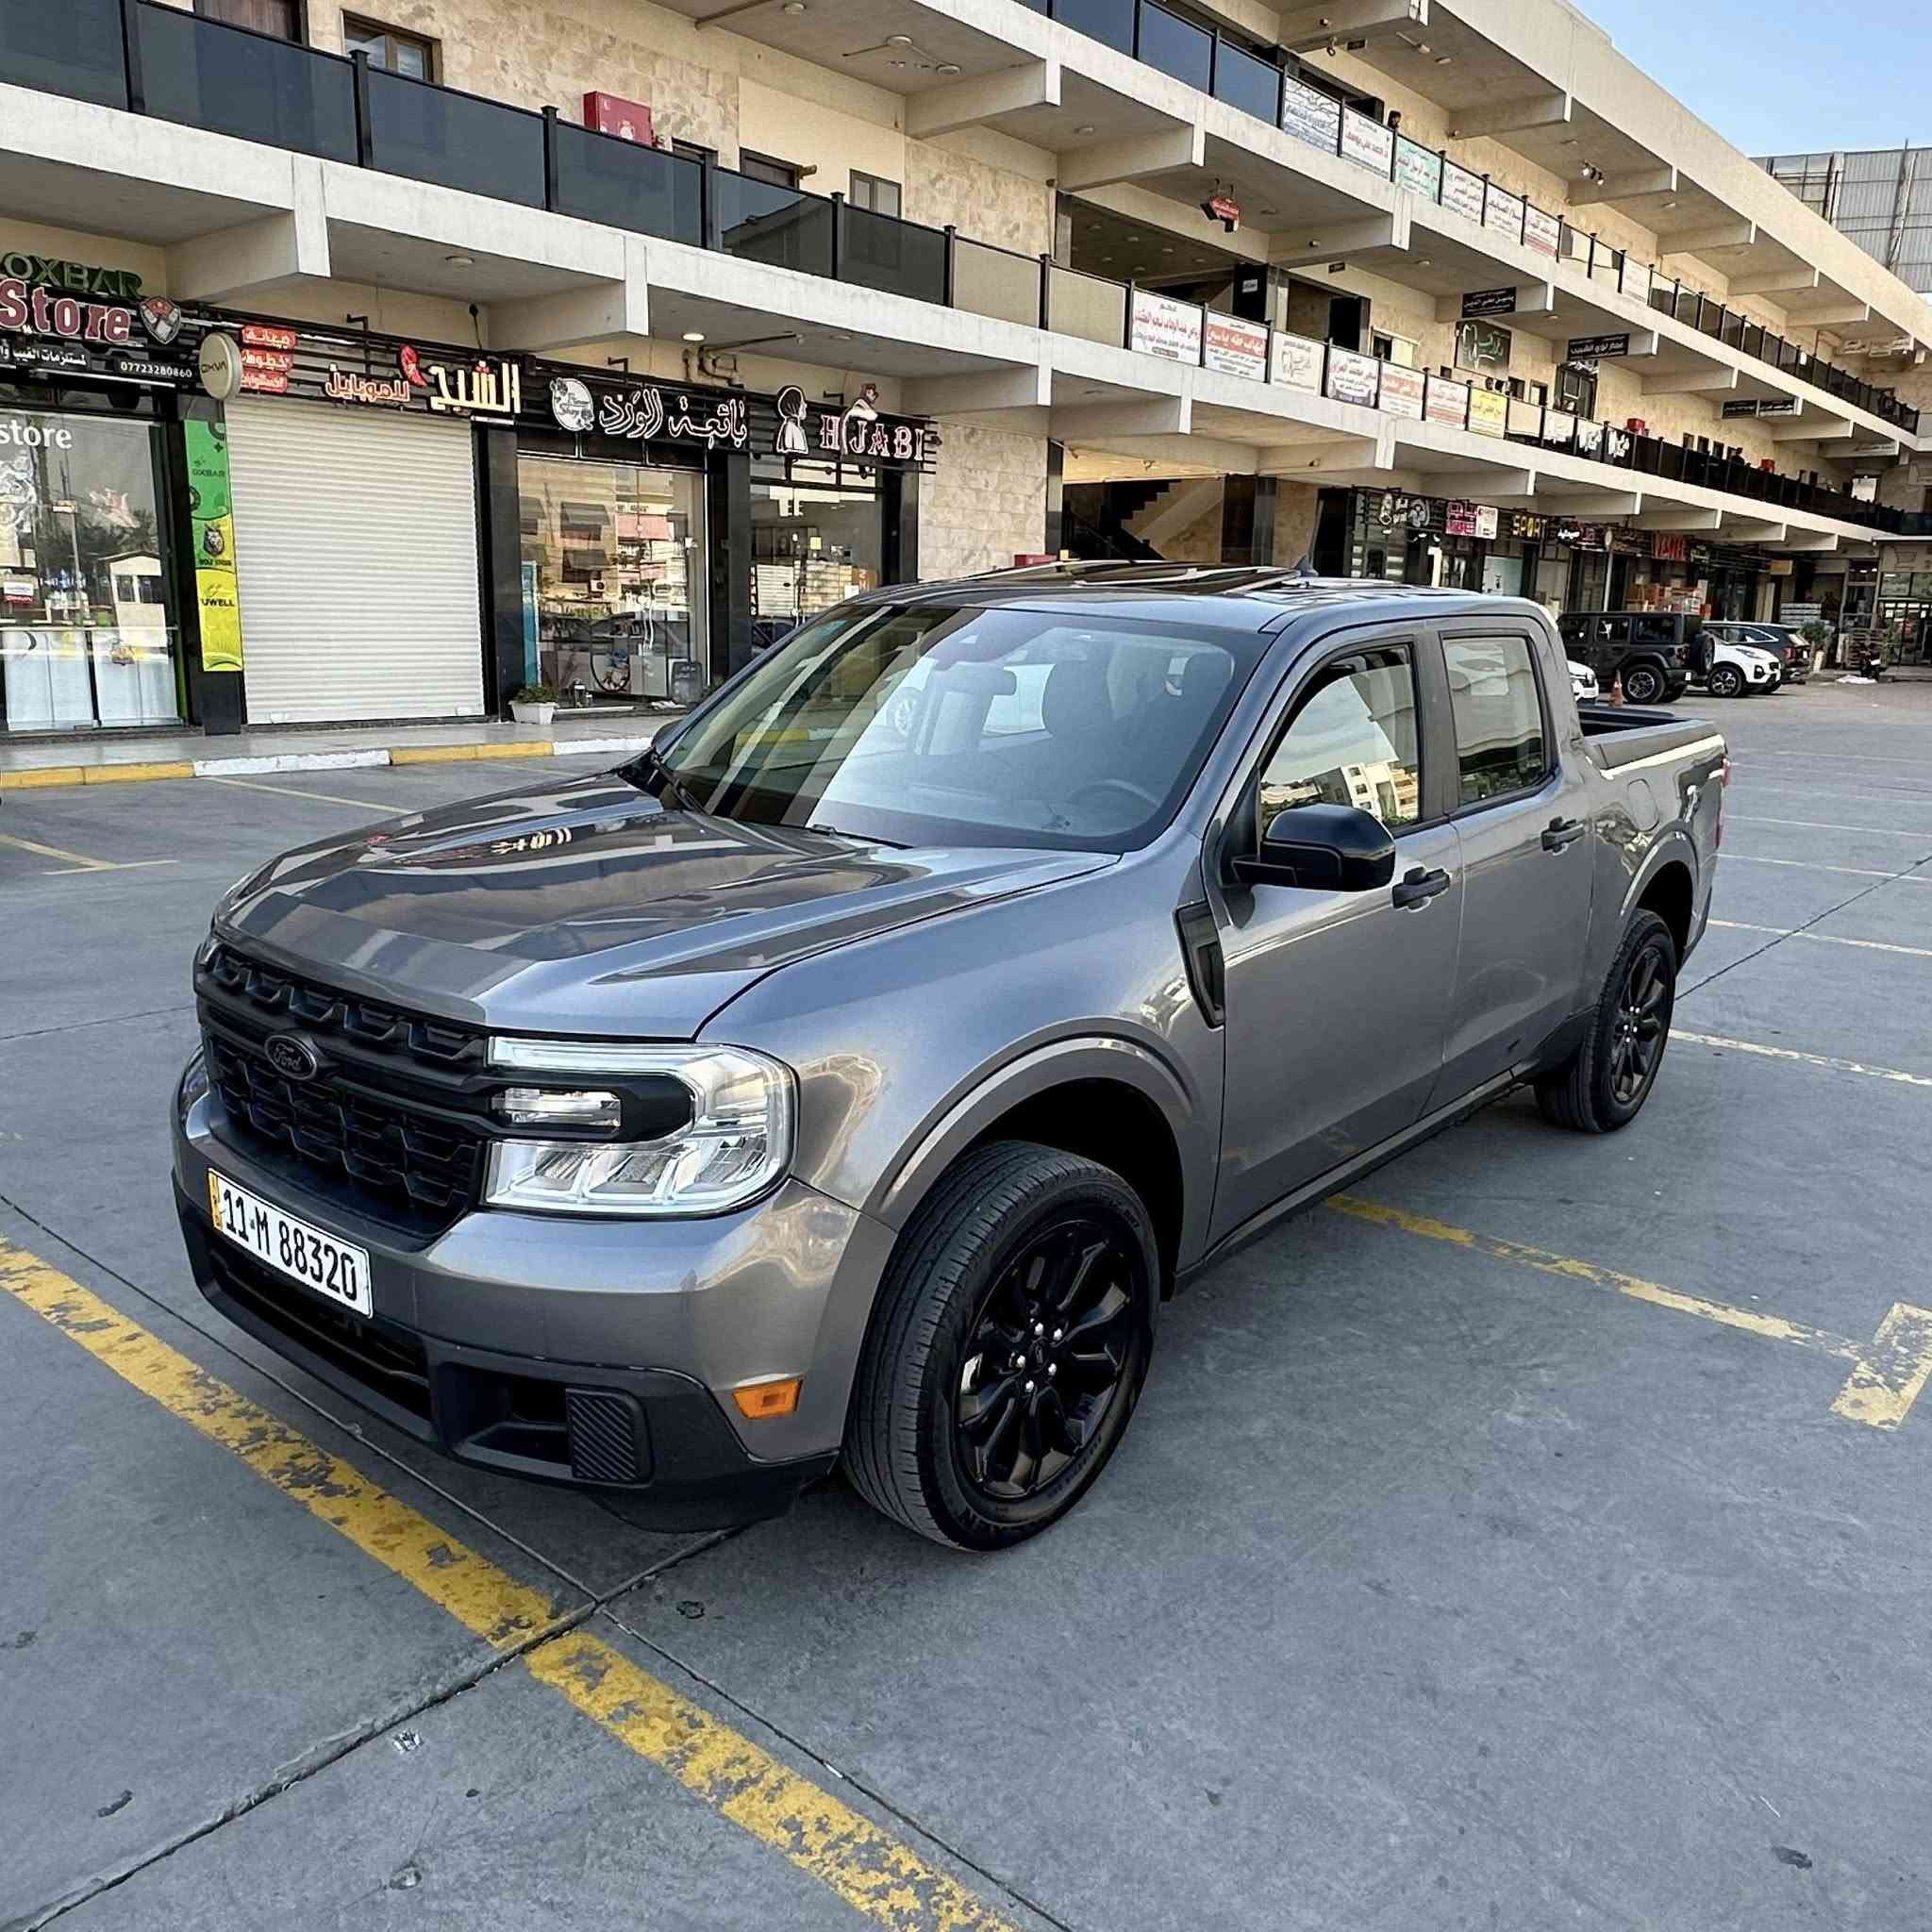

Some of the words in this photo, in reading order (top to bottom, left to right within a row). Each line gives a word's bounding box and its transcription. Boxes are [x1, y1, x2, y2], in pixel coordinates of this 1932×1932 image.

[3, 252, 143, 298] OXBAR
[0, 278, 131, 342] Store
[0, 419, 74, 449] store
[668, 395, 748, 450] بائعة
[200, 597, 235, 608] UWELL
[279, 1220, 358, 1301] 88320
